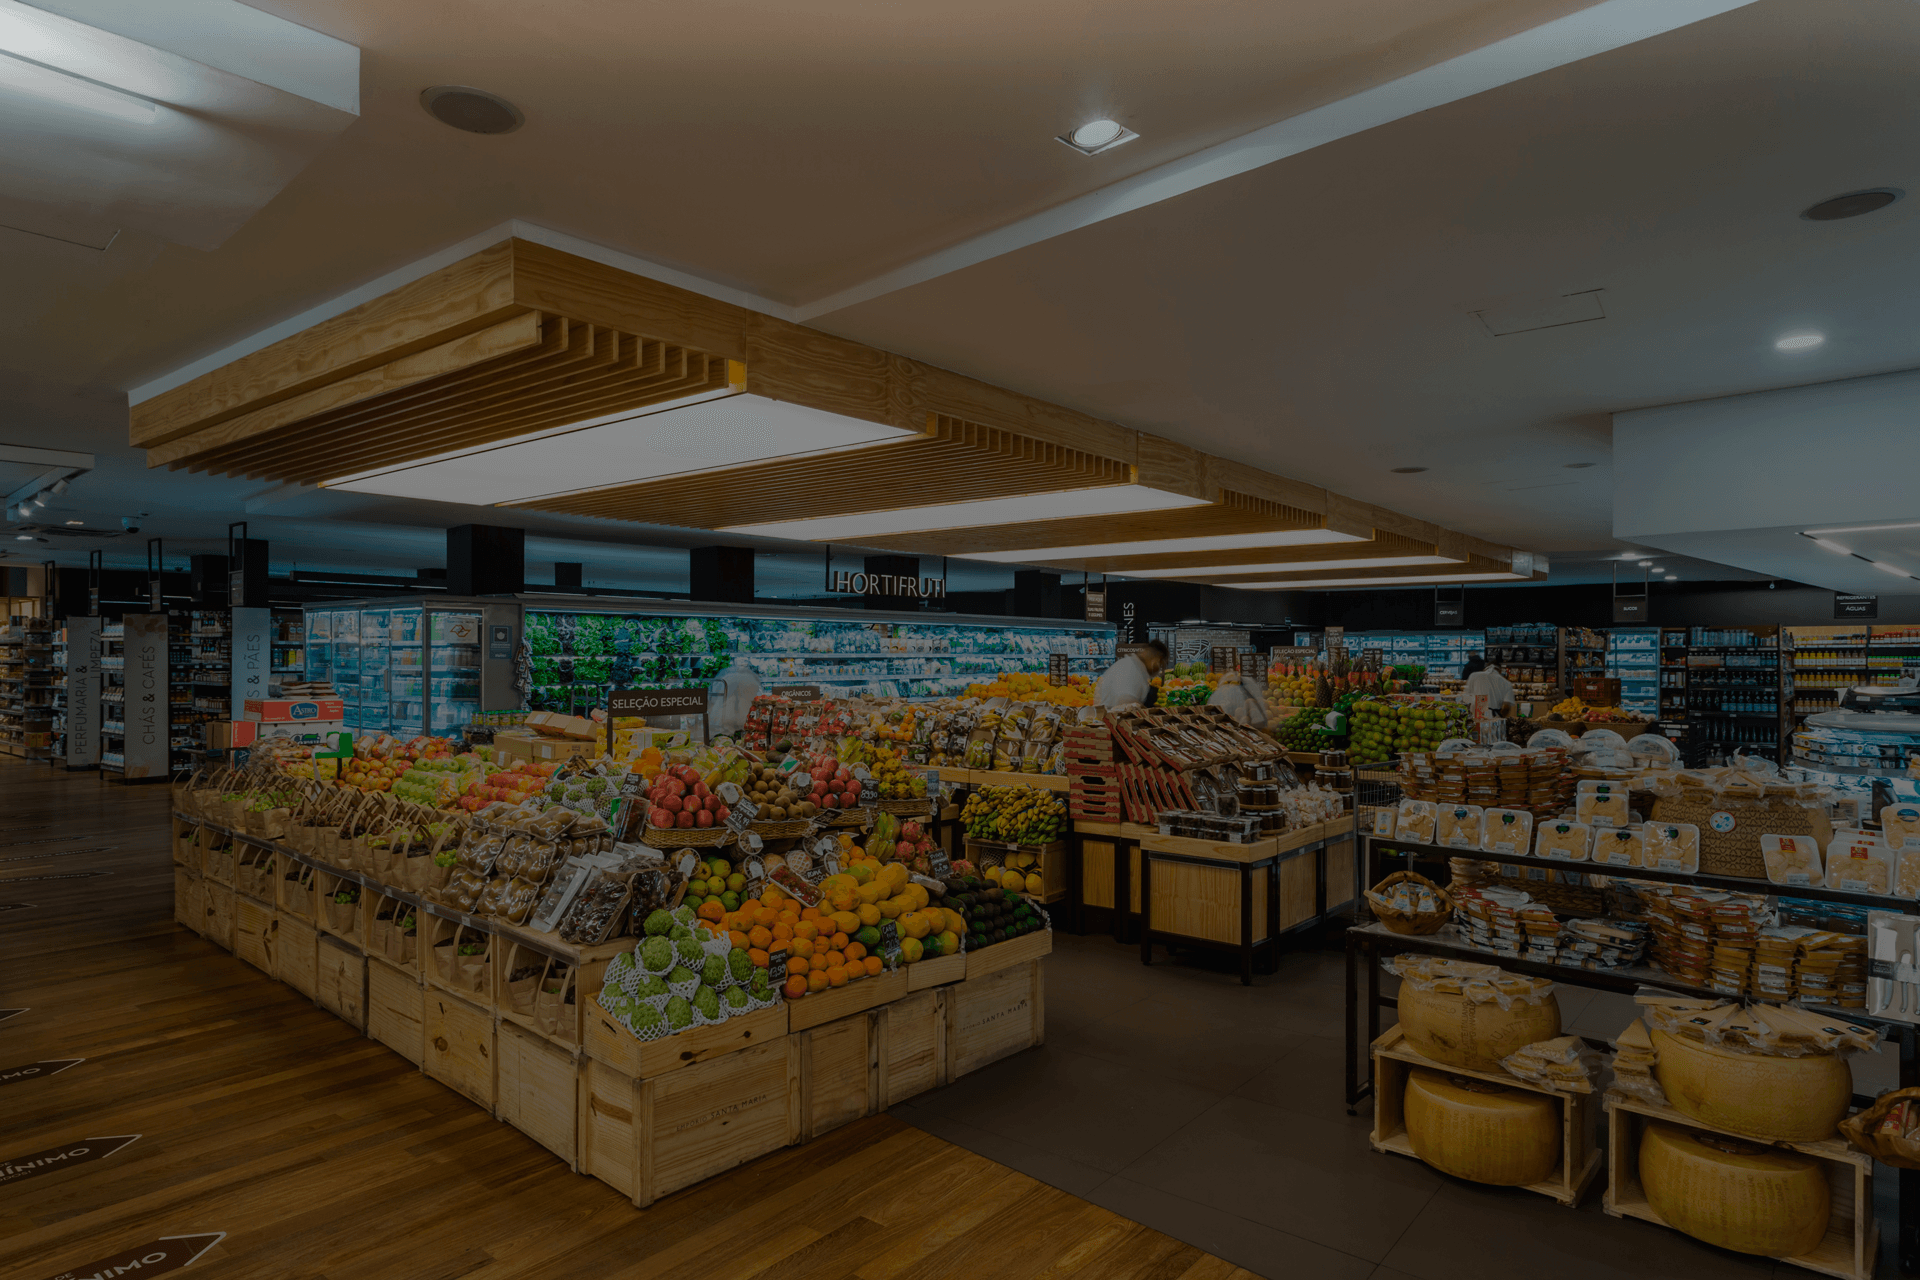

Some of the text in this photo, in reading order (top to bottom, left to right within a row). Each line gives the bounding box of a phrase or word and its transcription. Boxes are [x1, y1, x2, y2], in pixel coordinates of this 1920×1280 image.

[835, 571, 946, 599] HORTIFRUTI
[244, 634, 260, 670] PÃES
[247, 675, 259, 684] &
[138, 645, 155, 745] CHÁS & CAFÉS
[612, 695, 704, 711] SELEÇÃO ESPECIAL
[781, 689, 812, 697] ORGÂNICOS
[75, 665, 88, 754] PERFUMARIA &
[982, 1011, 1005, 1025] SANTA
[1007, 1001, 1028, 1015] MARIA
[710, 1104, 738, 1119] SANTA
[741, 1093, 768, 1108] MARIA
